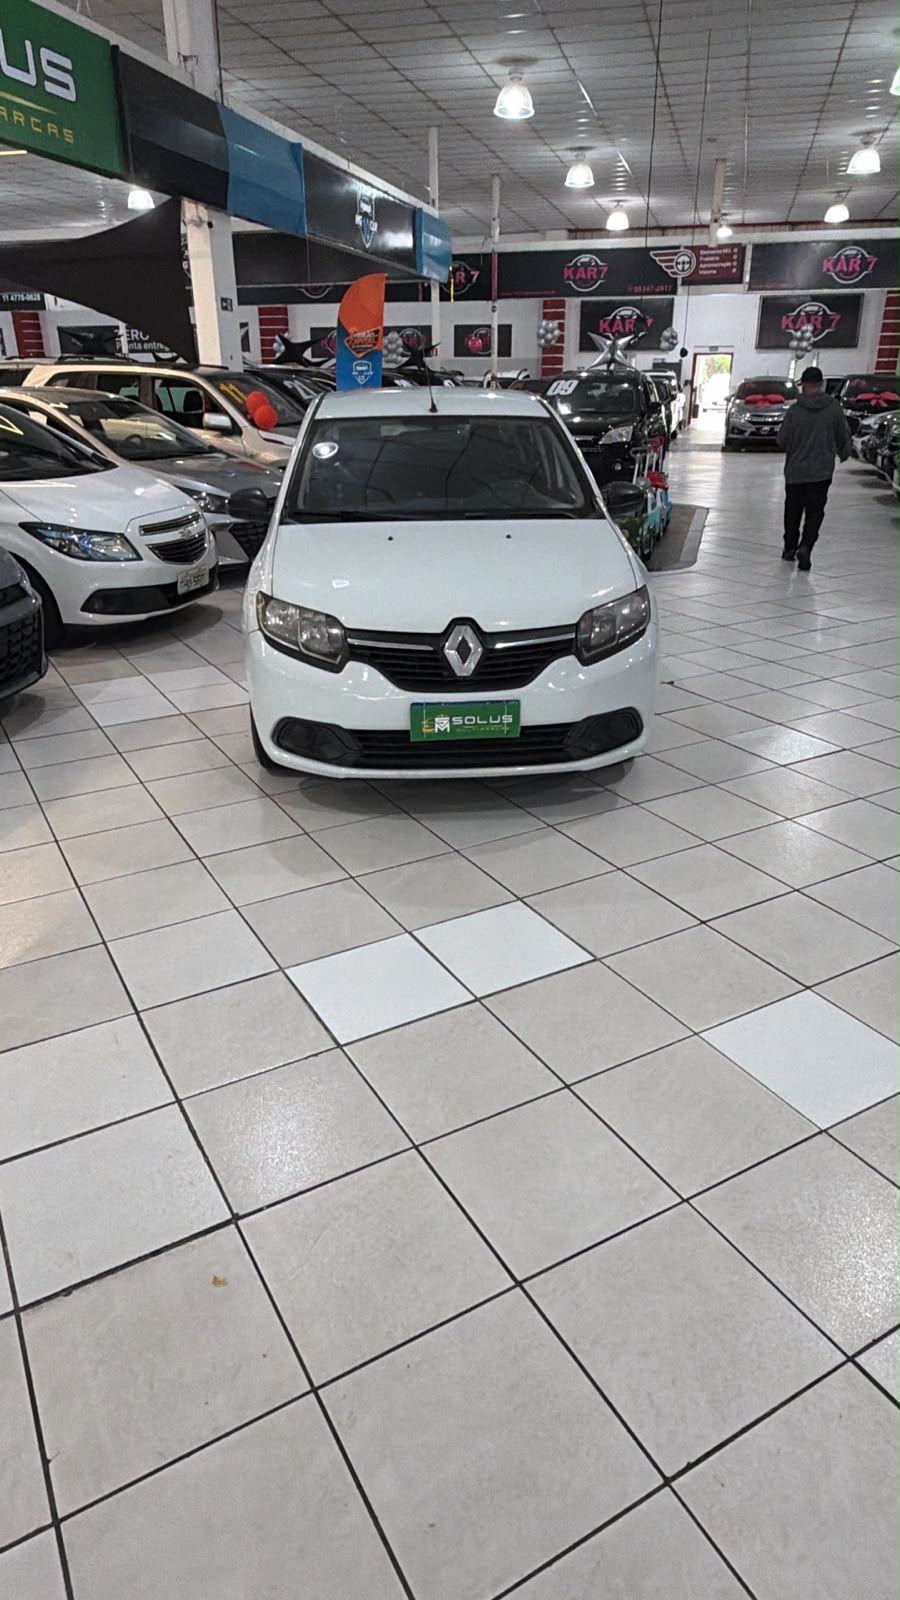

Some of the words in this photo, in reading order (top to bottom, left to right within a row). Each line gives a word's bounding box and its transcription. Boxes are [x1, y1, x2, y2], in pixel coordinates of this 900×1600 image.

[822, 257, 861, 273] KAR
[867, 256, 878, 271] 7
[563, 266, 598, 280] KAR
[599, 266, 609, 278] 7
[546, 380, 579, 395] 09
[452, 715, 513, 725] SOLUS
